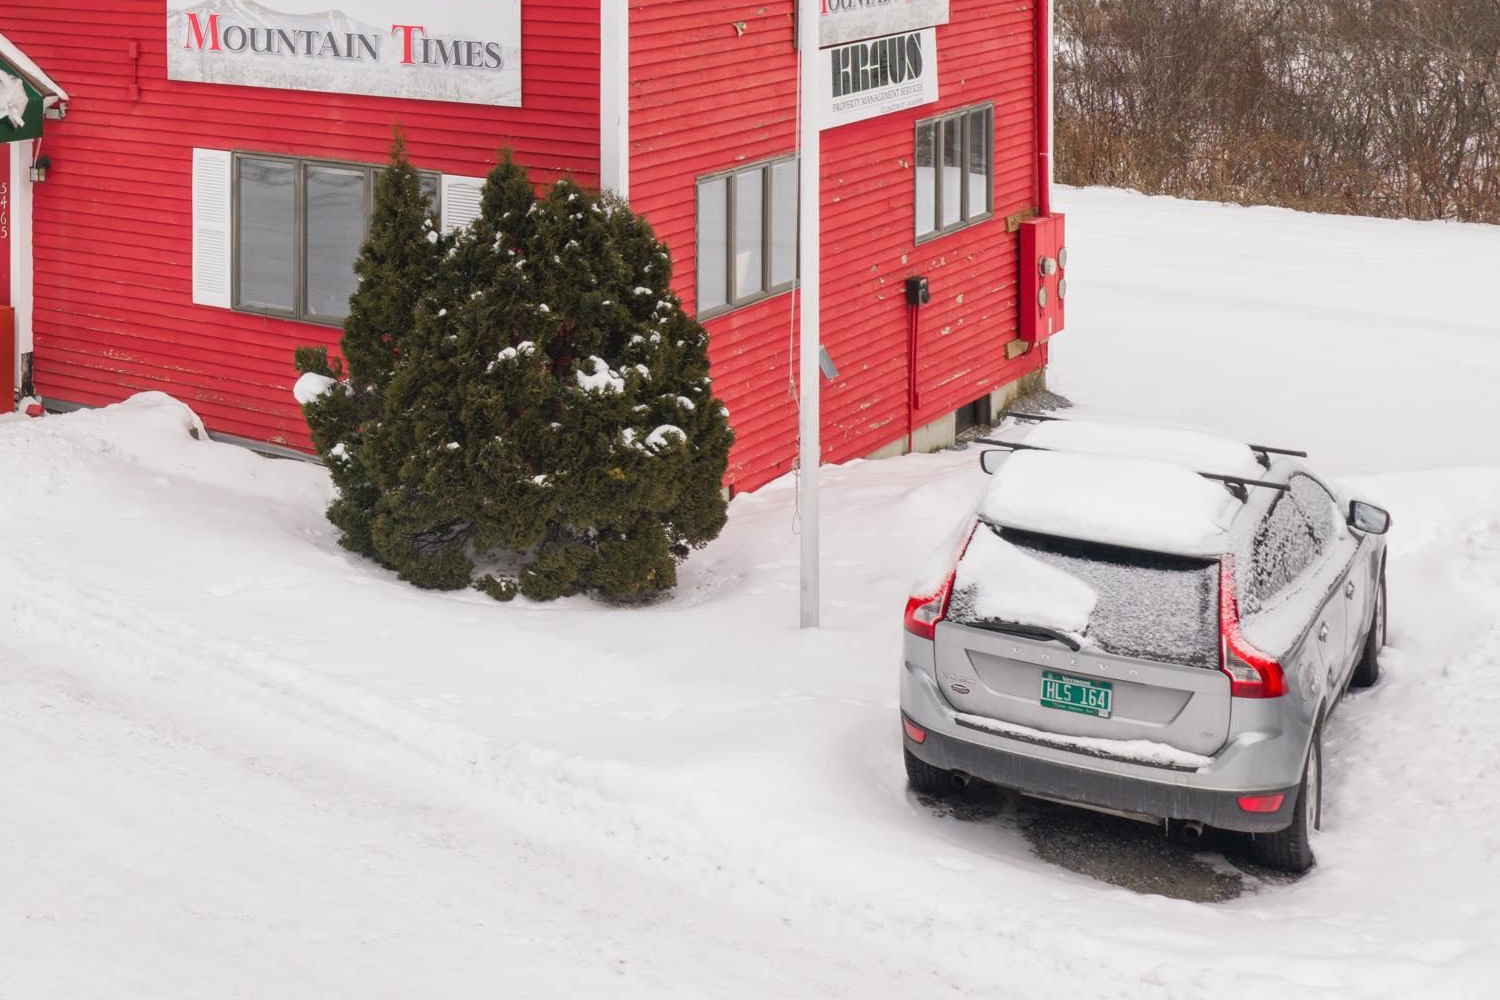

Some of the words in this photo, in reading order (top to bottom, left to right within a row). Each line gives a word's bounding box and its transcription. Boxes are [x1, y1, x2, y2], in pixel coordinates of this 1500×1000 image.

[183, 12, 379, 61] MOUNTAIN
[391, 24, 502, 69] TIMES
[831, 32, 923, 98] KRAUS
[0, 182, 8, 239] 5465
[1046, 681, 1072, 701] HLS
[1080, 687, 1105, 708] 164
